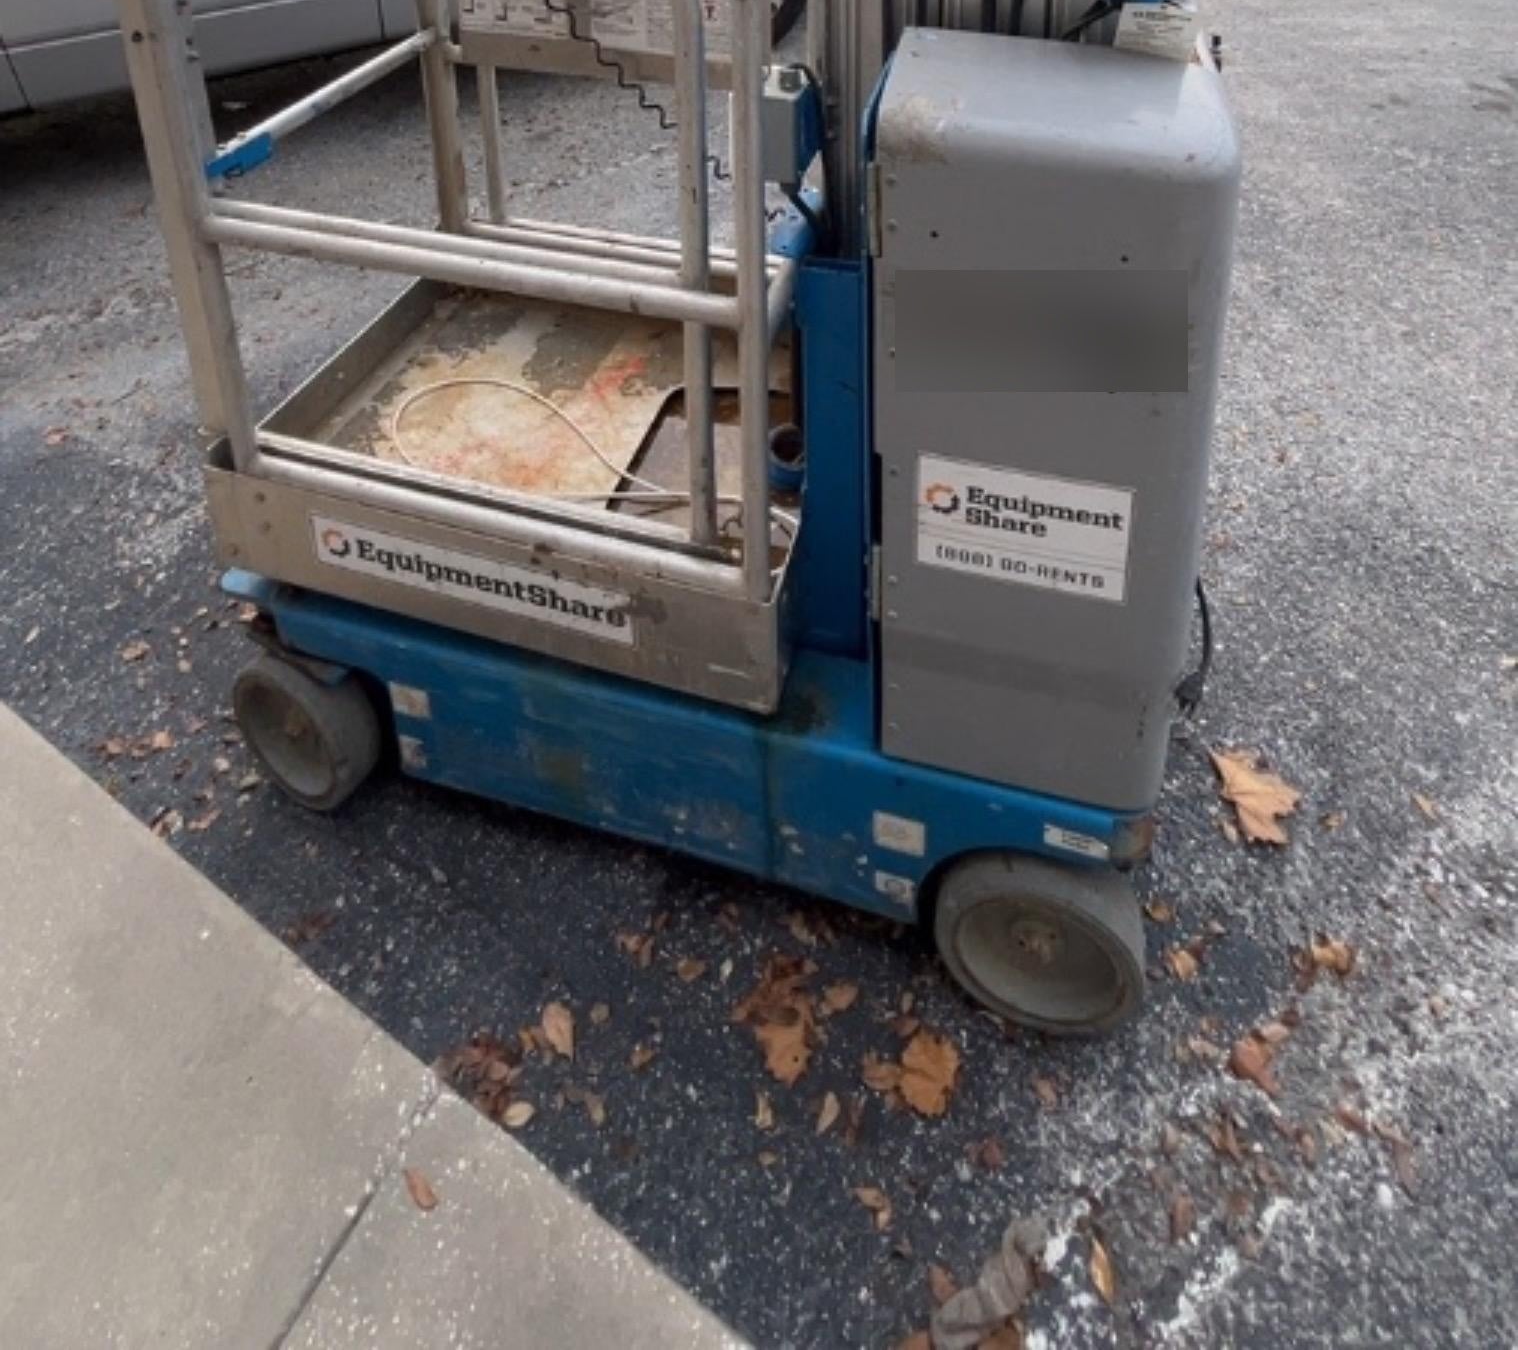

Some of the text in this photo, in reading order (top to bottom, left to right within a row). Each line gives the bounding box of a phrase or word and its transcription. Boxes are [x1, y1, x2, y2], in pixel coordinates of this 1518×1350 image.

[965, 484, 1124, 531] Equipment
[965, 506, 1048, 538] Share
[356, 538, 627, 628] EquipmentShare
